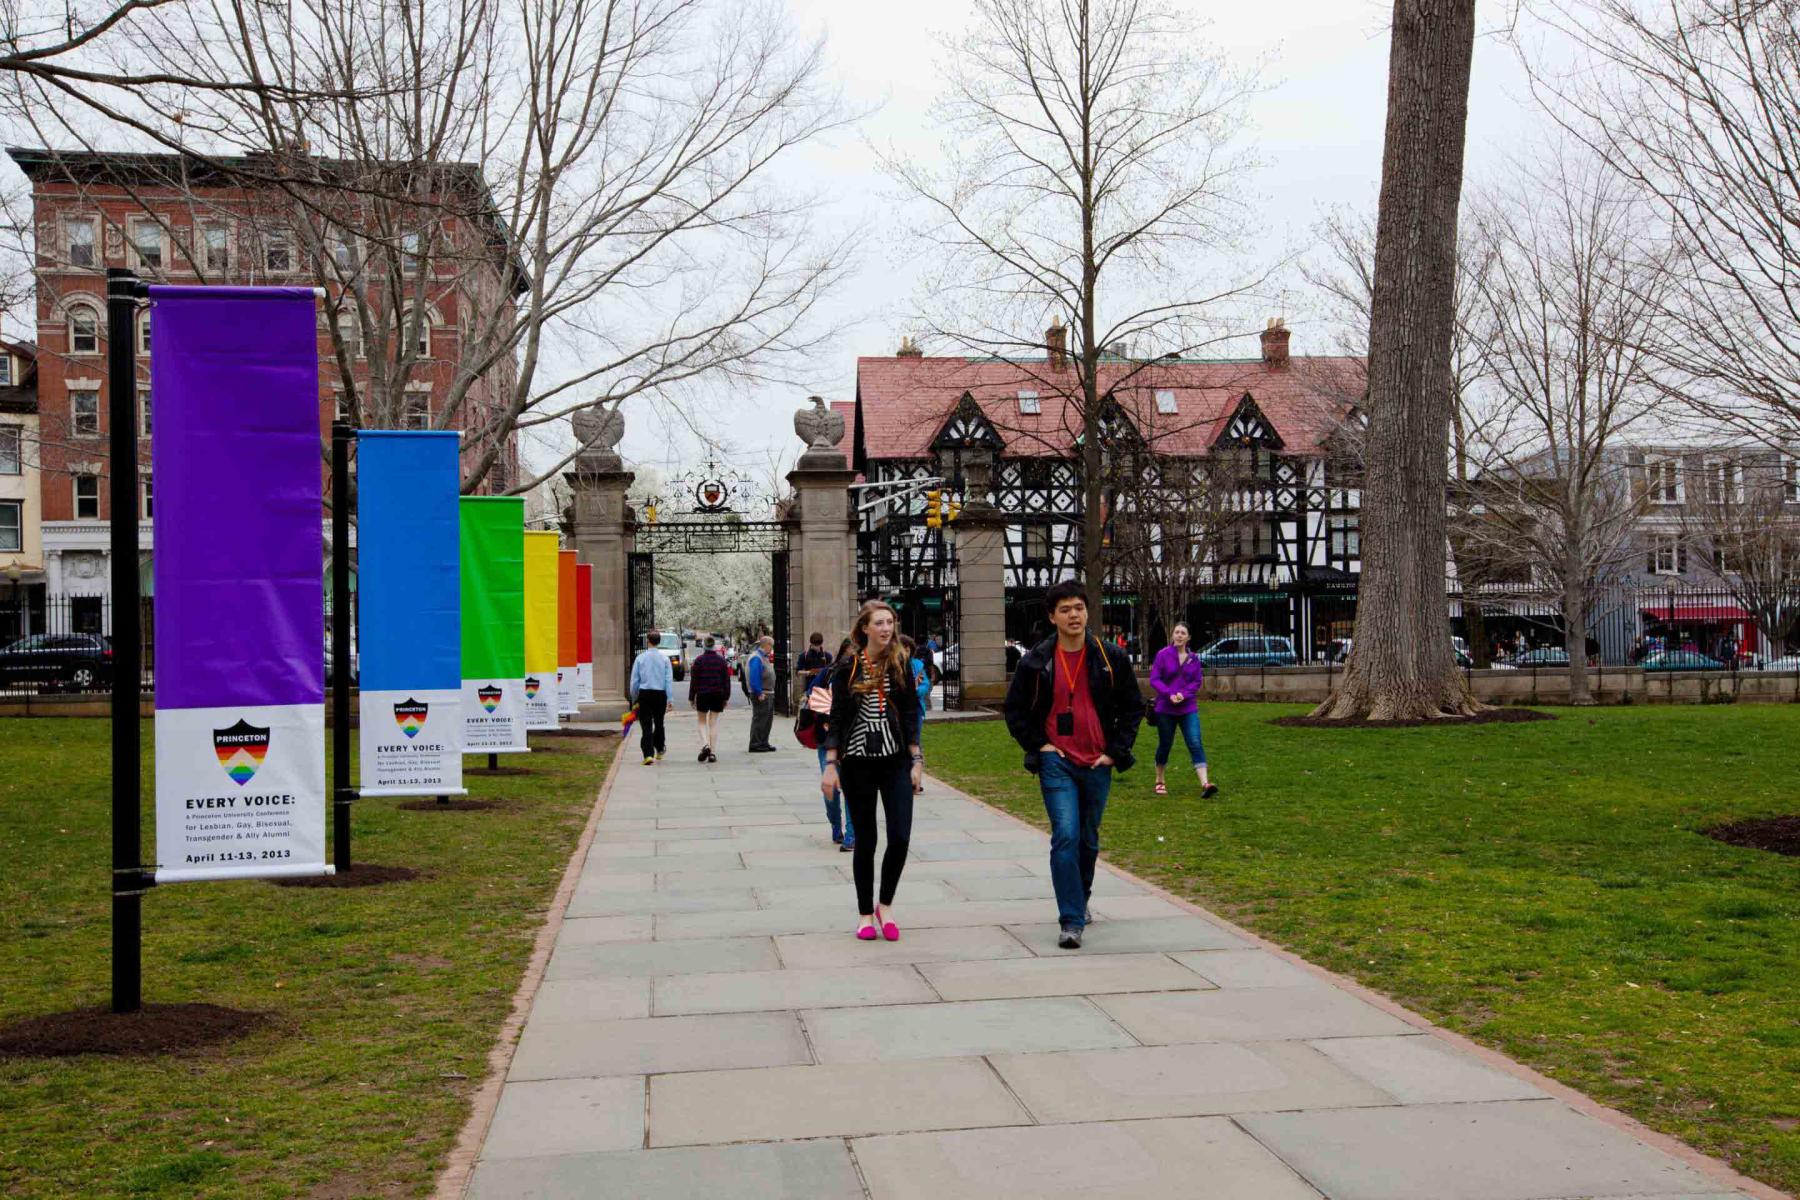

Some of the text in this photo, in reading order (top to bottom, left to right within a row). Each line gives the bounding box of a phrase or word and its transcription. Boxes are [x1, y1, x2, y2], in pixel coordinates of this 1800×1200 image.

[216, 734, 267, 743] PRINCETON
[377, 744, 445, 753] EVERY VOICE:
[186, 794, 296, 809] EVERY VOICE:
[200, 823, 234, 831] Lesbian,
[236, 822, 253, 830] Gay,
[185, 834, 233, 843] Transgender
[245, 832, 260, 840] Ally
[186, 849, 291, 864] April 11-13, 2013
